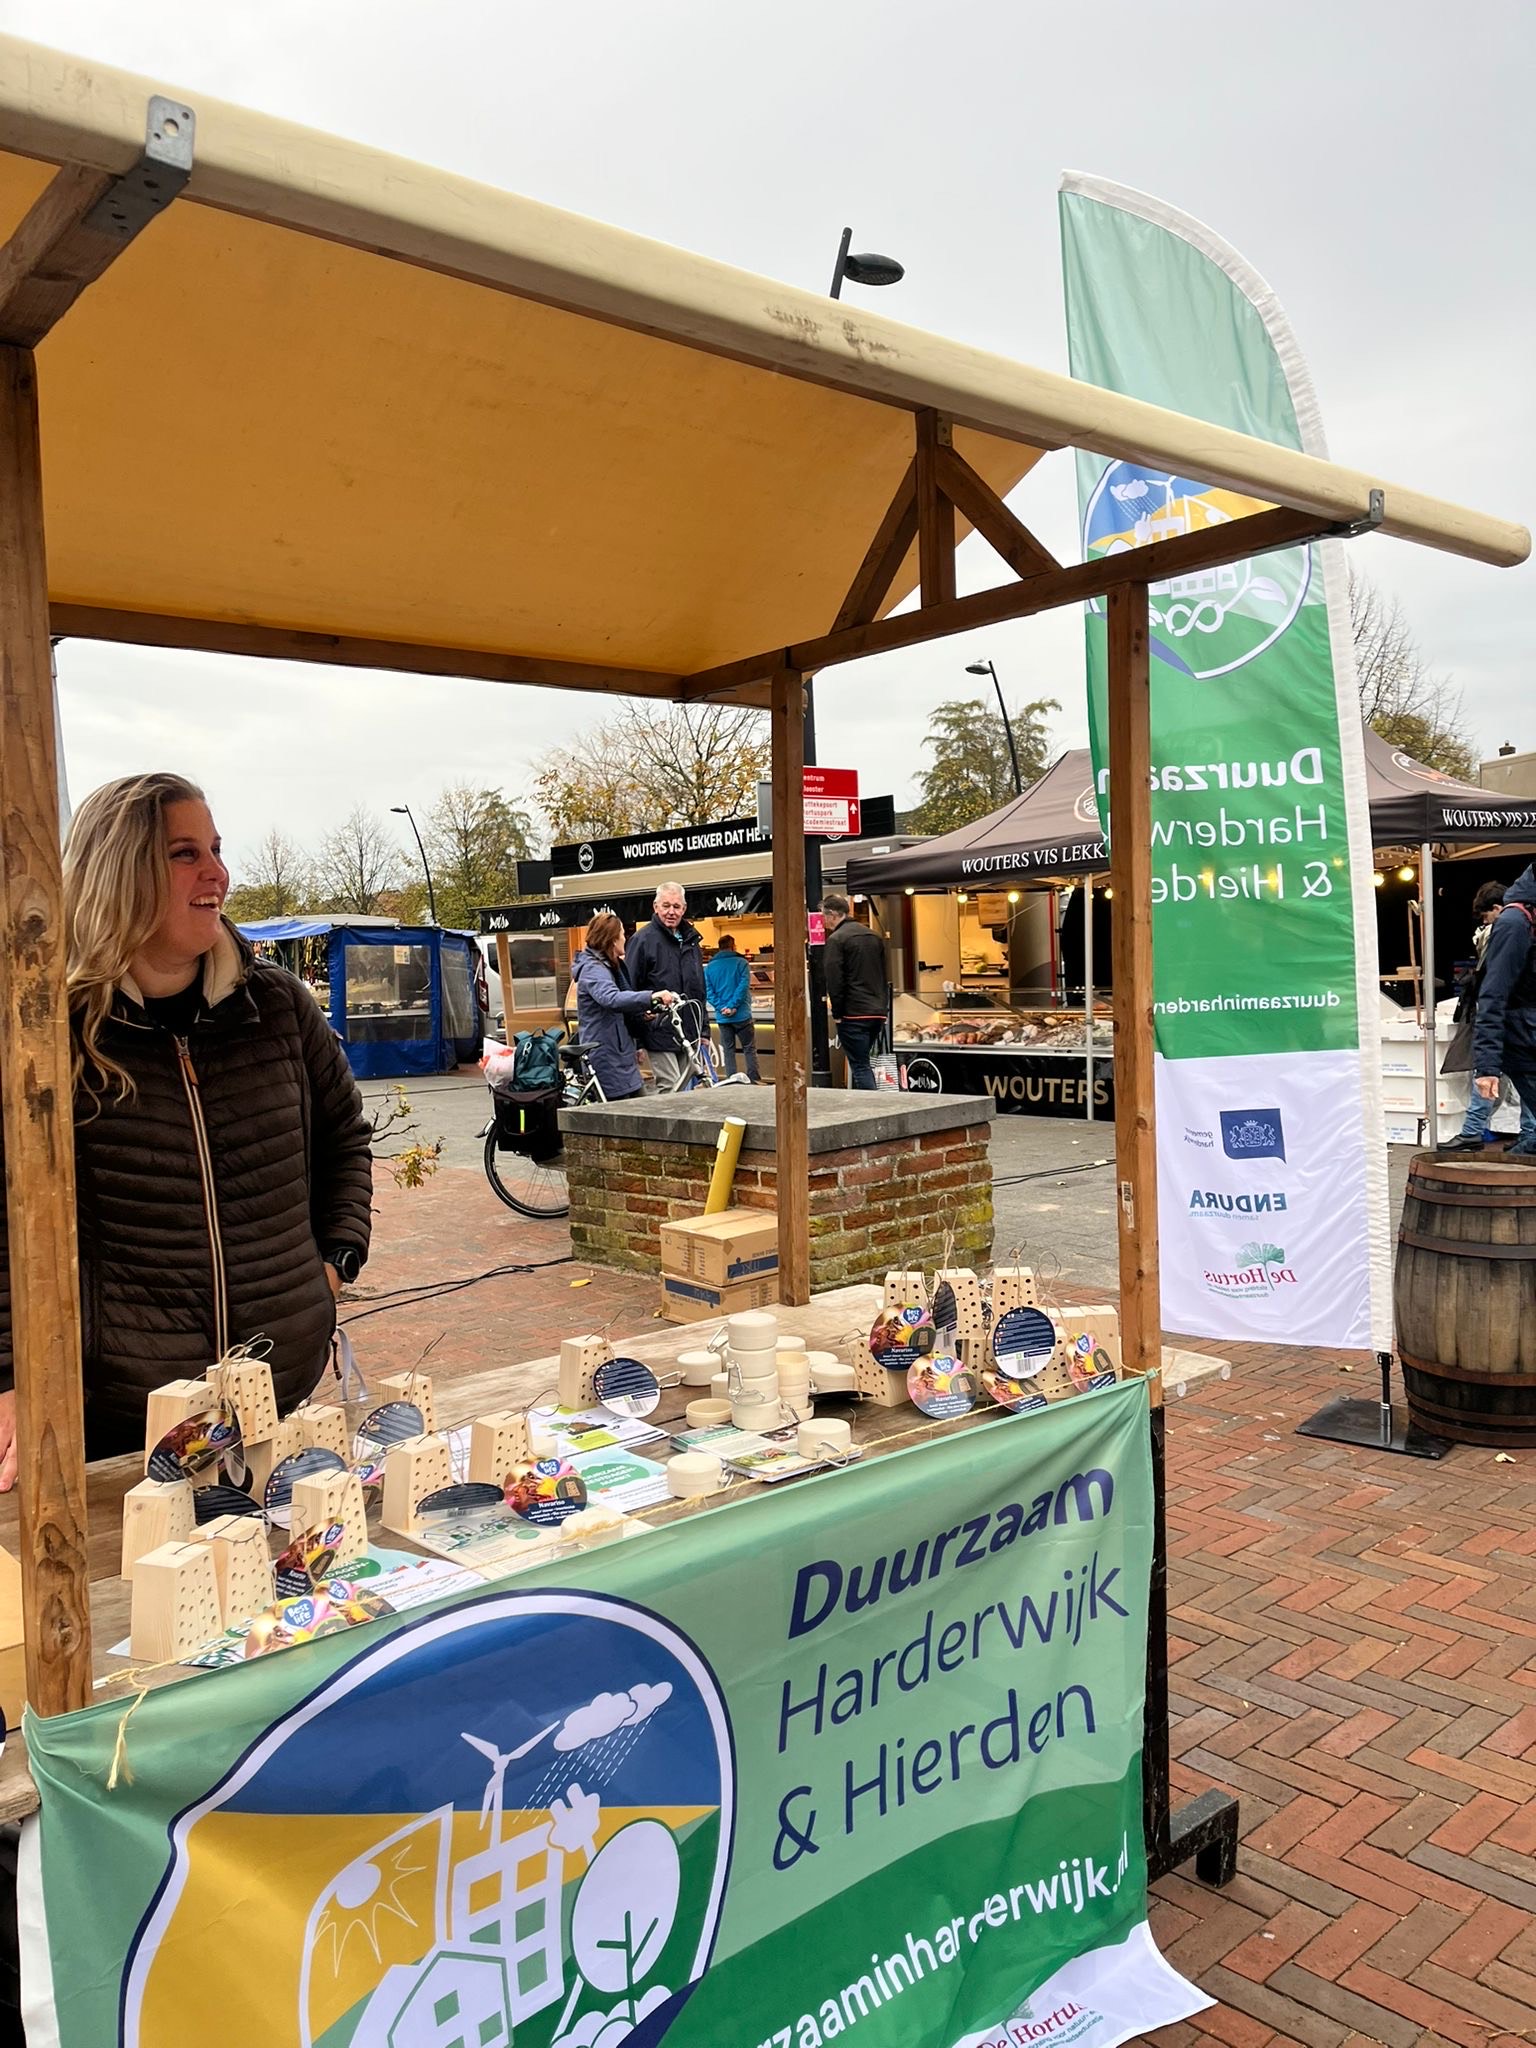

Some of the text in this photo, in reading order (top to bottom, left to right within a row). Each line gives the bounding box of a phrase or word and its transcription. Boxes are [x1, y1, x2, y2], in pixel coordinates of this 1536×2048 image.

[803, 774, 825, 782] entrum
[803, 785, 824, 793] looster
[804, 801, 838, 809] uttekepoort
[804, 809, 833, 817] ortuspark
[1442, 808, 1501, 828] WOUTERS
[1502, 811, 1522, 828] VIS
[622, 840, 668, 859] WOUTERS
[668, 837, 684, 853] VIS
[687, 832, 723, 850] LEKKER
[725, 829, 744, 846] DAT
[961, 841, 1109, 874] WOUTERS VIS LEKK
[983, 1074, 1110, 1105] WOUTERS
[787, 1467, 1115, 1640] Duurzaam
[287, 1603, 310, 1617] Best
[292, 1609, 311, 1625] life
[777, 1550, 1130, 1754] Harderwijk
[772, 1683, 1097, 1872] & Hierden
[757, 1830, 1128, 2048] zaaminharderwijk.nl
